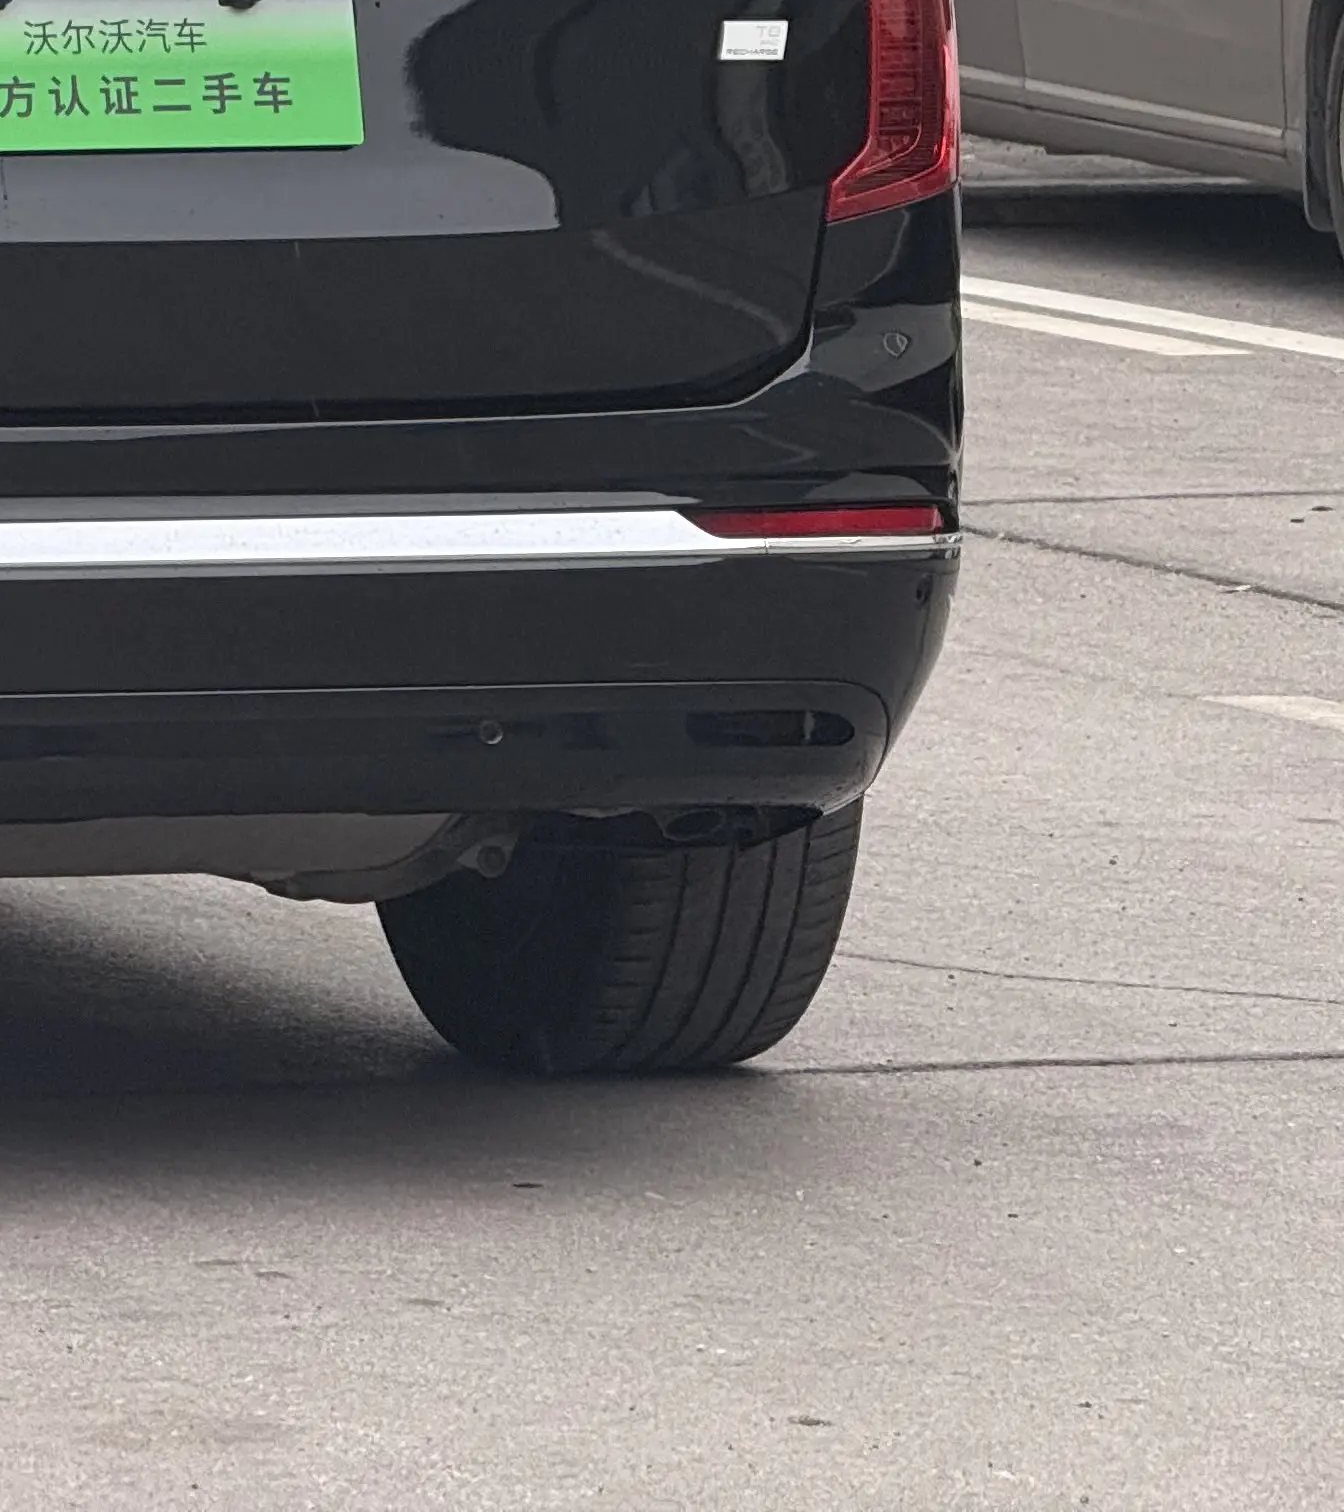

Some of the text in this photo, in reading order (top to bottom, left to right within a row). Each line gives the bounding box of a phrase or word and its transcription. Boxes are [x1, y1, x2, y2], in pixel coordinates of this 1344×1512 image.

[23, 17, 208, 56] 沃尔沃汽车
